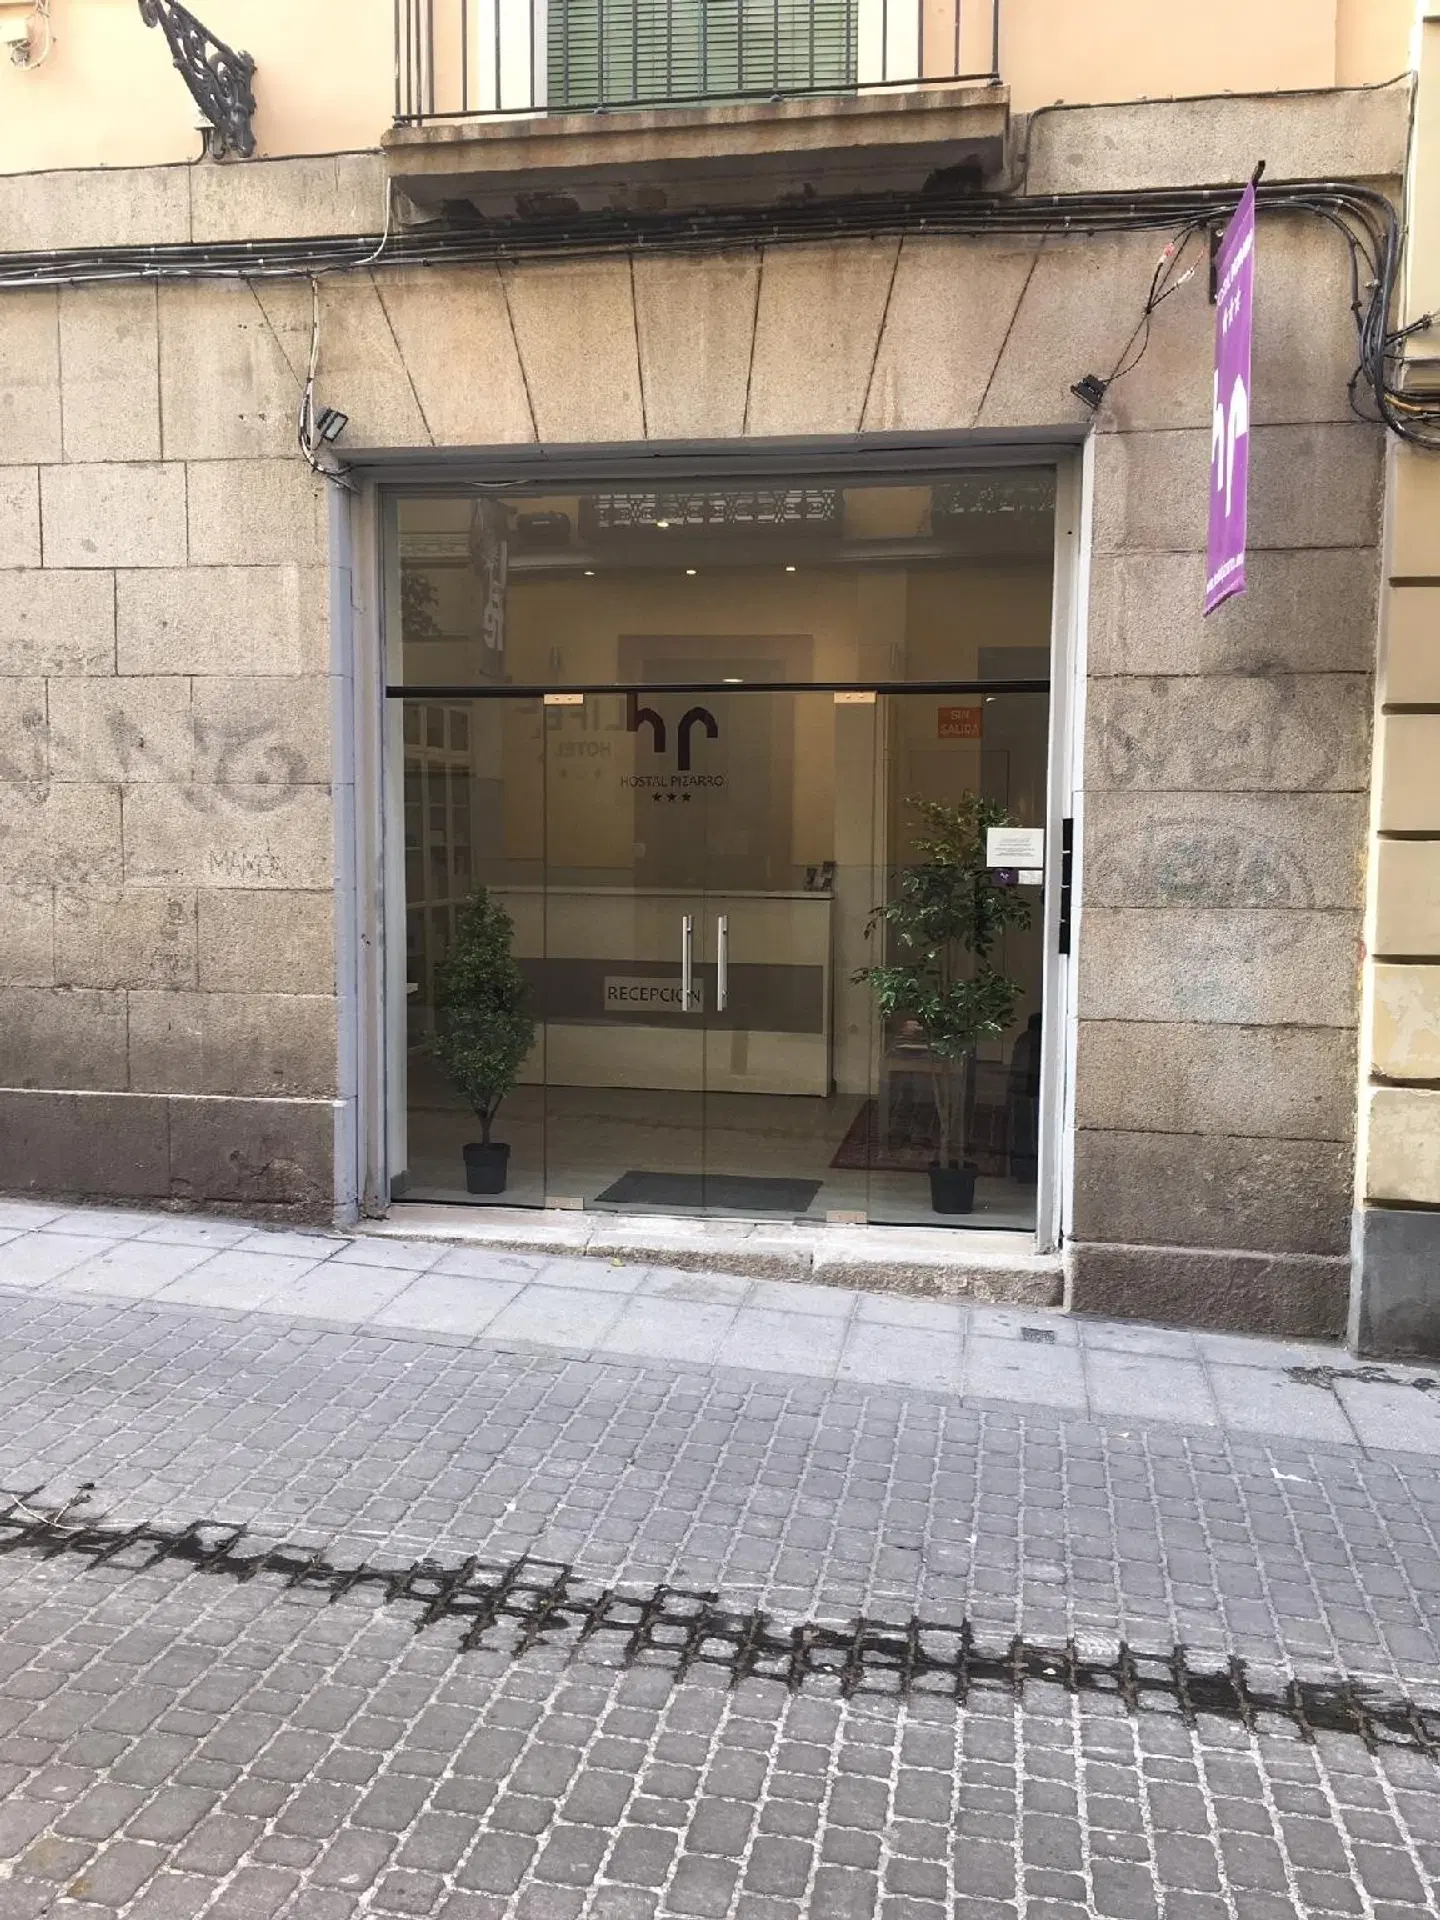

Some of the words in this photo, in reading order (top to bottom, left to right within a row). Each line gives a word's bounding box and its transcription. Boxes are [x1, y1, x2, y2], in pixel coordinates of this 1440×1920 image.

[951, 710, 970, 720] SIN
[941, 723, 980, 736] SALIDA
[621, 776, 668, 788] HOSTAL
[671, 775, 724, 787] PIZARRO
